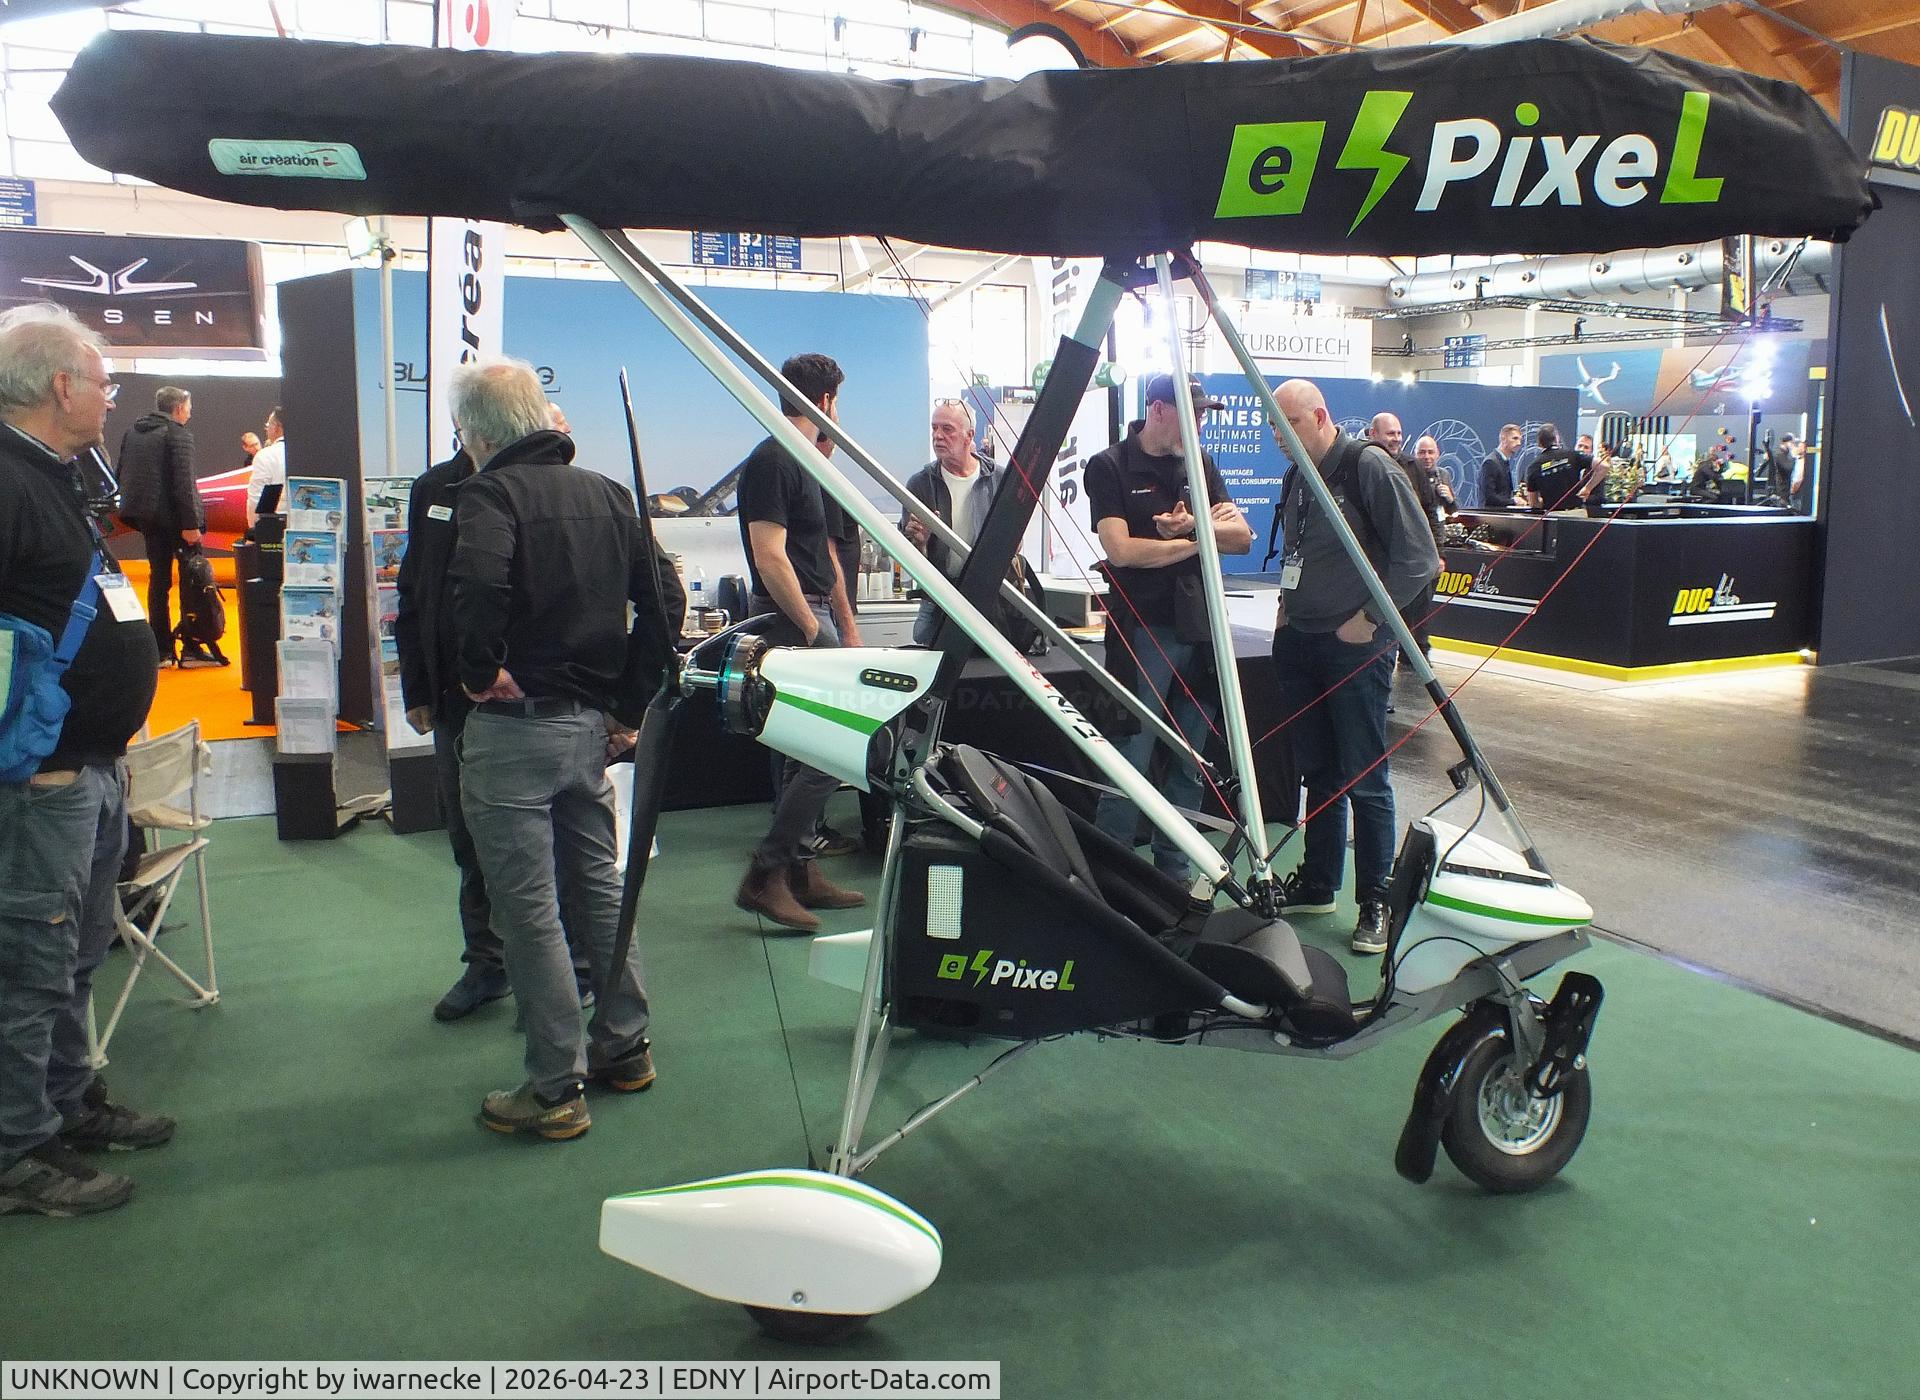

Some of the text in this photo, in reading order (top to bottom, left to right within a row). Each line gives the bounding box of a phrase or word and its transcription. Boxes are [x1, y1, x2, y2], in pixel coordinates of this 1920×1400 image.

[1874, 109, 1920, 165] DU
[239, 152, 257, 165] air
[1247, 91, 1725, 212] e PixeL
[739, 231, 763, 247] B2
[103, 308, 214, 325] SEN
[1237, 333, 1350, 355] TURBOTECH
[1205, 429, 1261, 440] ULTIMATE
[1435, 571, 1473, 596] DUC
[1672, 587, 1714, 614] DUC
[946, 959, 1076, 991] e PixeL
